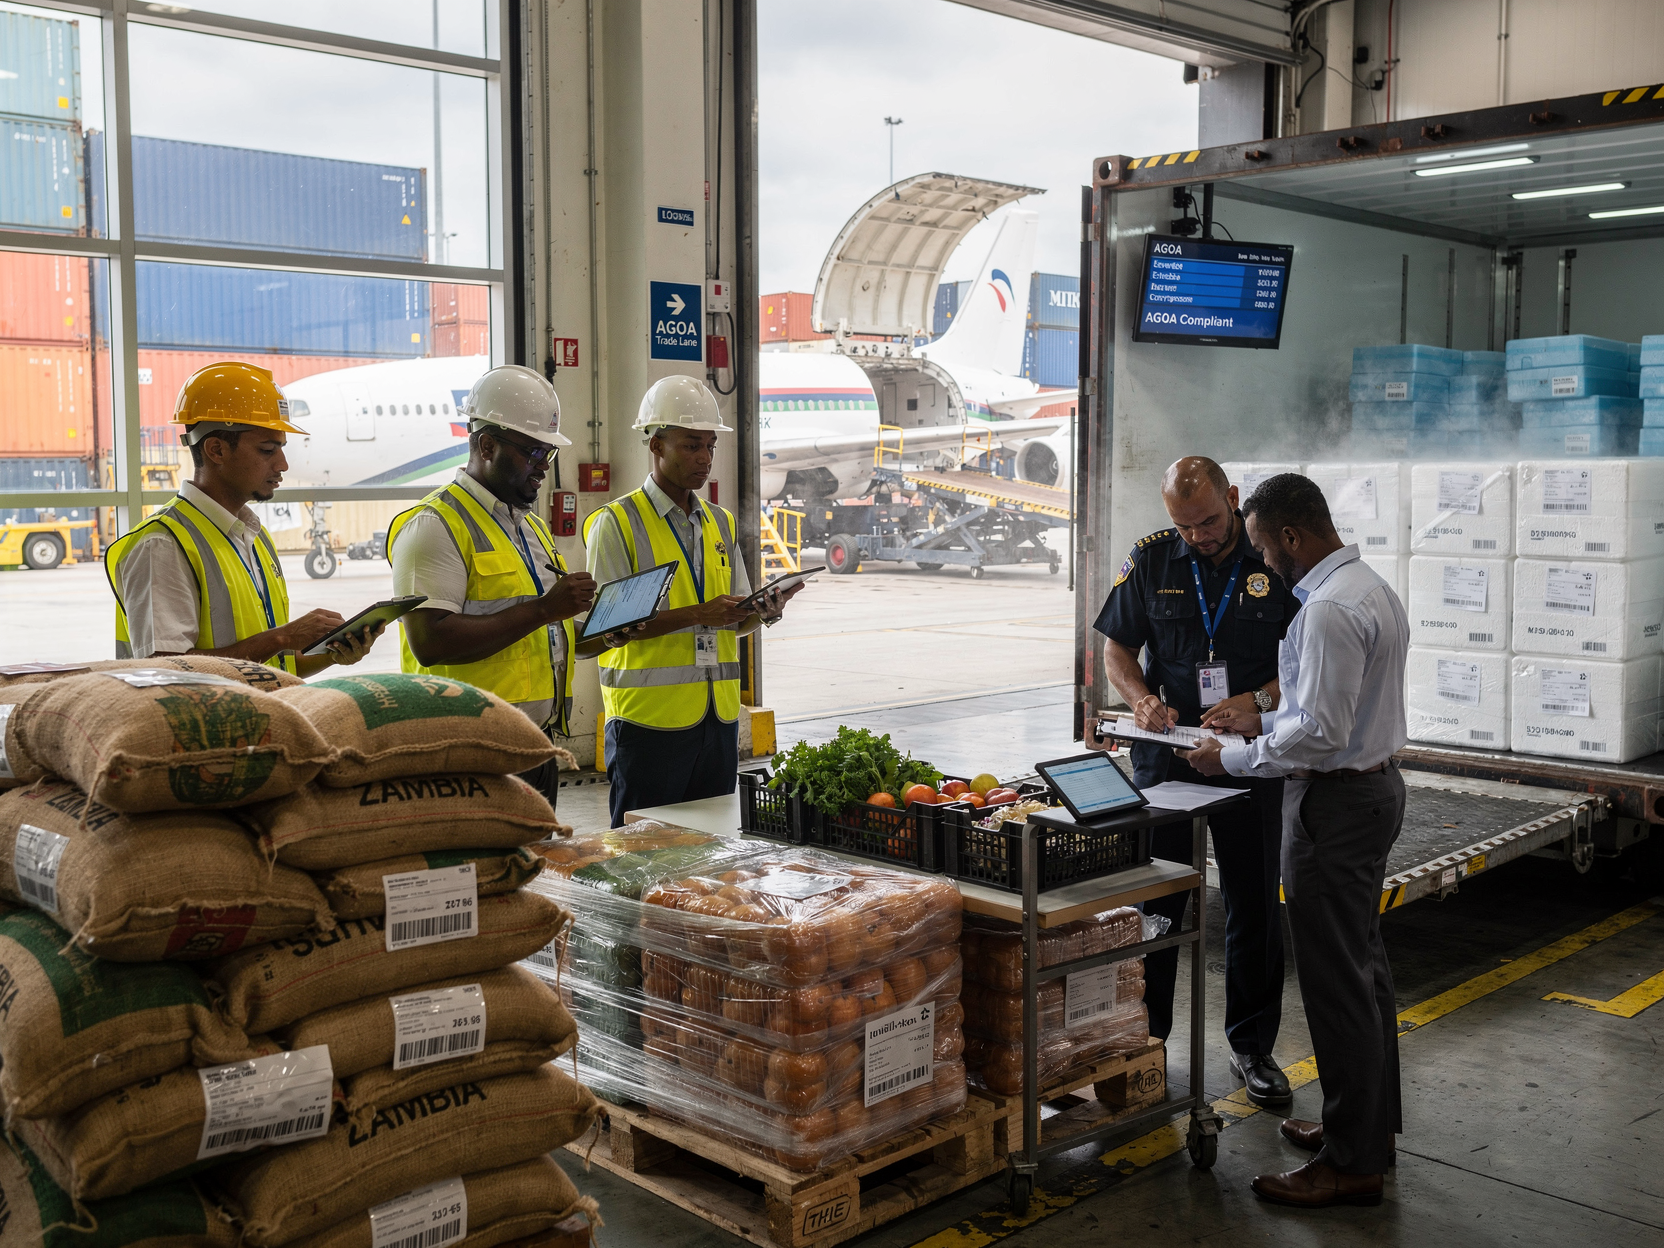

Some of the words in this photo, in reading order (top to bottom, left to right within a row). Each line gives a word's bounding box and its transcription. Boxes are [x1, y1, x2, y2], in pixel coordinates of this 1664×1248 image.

[1154, 243, 1182, 255] AGOA
[656, 320, 697, 336] AGOA
[1145, 312, 1177, 324] AGOA
[1180, 314, 1234, 328] Compliant
[655, 335, 677, 346] Trade
[679, 337, 697, 346] Lane
[358, 777, 490, 807] ZAMBIA
